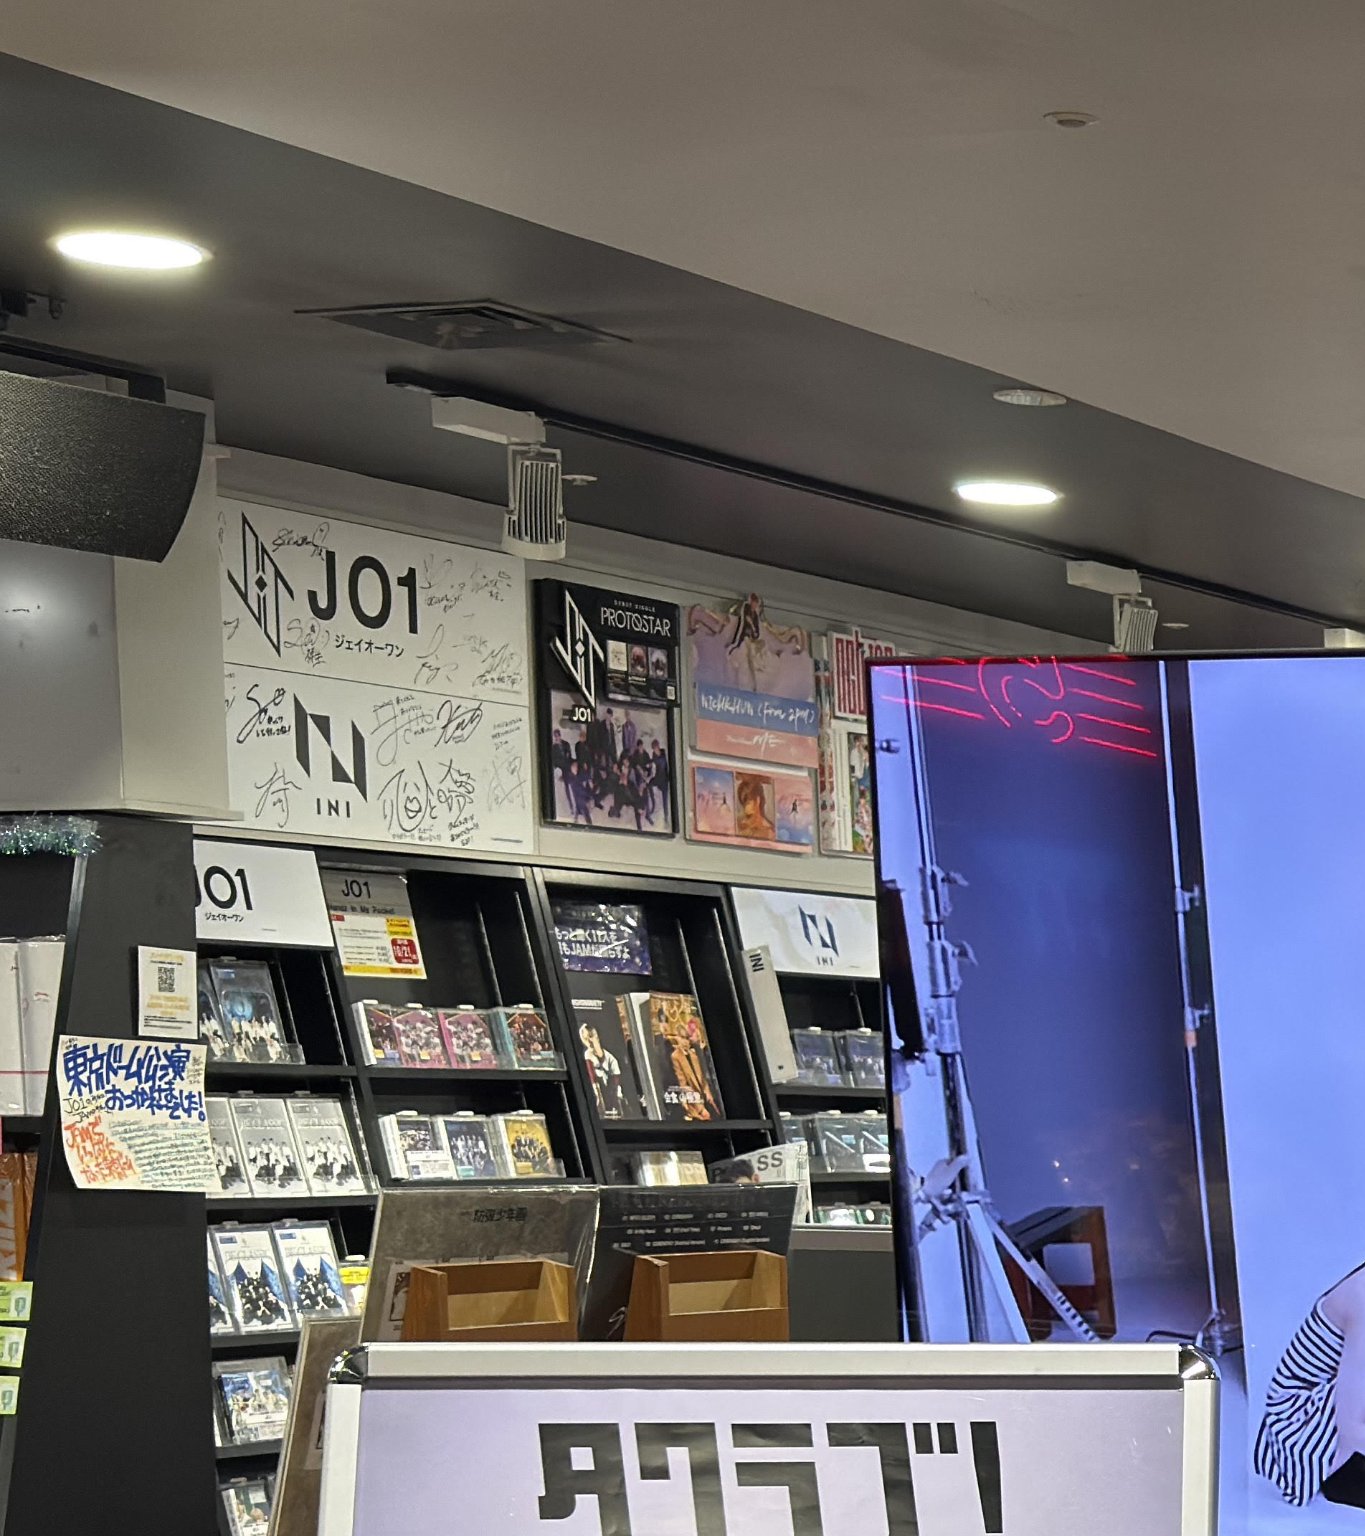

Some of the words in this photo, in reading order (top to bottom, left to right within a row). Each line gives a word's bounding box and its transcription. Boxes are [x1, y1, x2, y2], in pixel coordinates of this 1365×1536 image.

[308, 551, 418, 635] JO1
[335, 634, 404, 658] ジェイオーワン
[573, 707, 592, 723] JO1
[316, 798, 351, 818] INI
[194, 864, 253, 911] O1
[342, 879, 371, 900] JO1
[817, 956, 834, 967] INI
